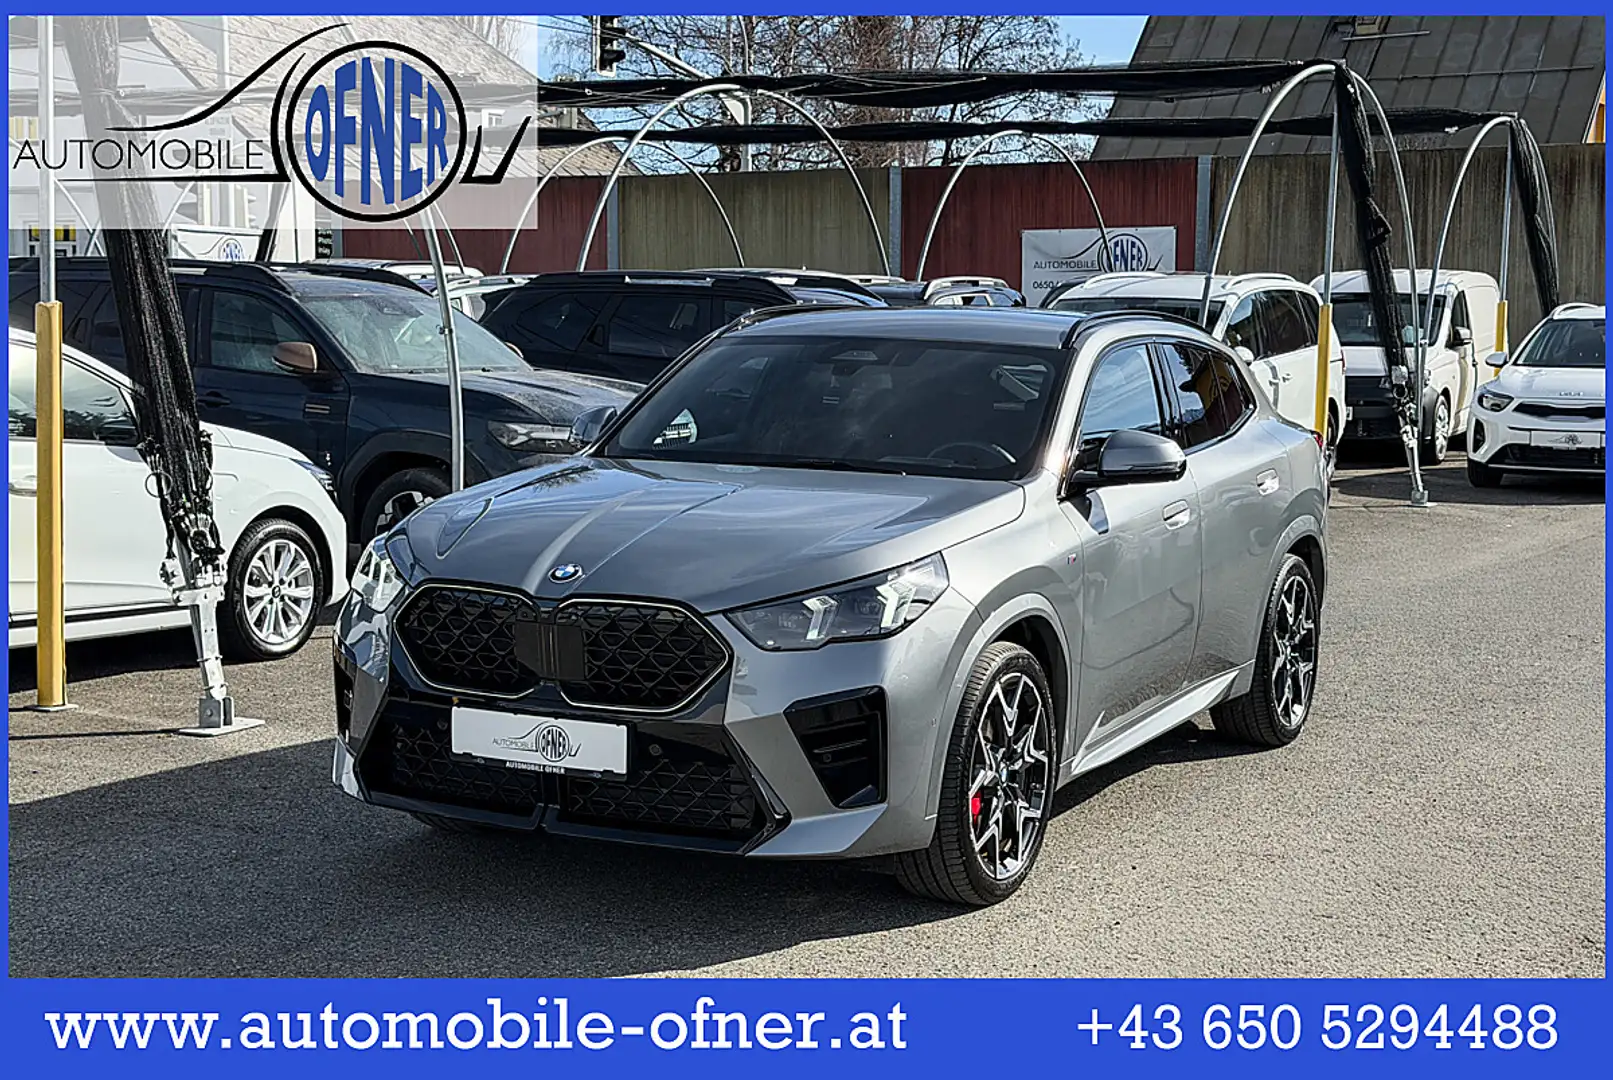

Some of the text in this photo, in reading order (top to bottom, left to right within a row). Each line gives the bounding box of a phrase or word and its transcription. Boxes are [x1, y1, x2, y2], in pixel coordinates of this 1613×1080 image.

[1033, 260, 1097, 270] AUTOMOBILE
[540, 728, 567, 760] OFNER
[505, 761, 544, 772] AUTOMOBILE
